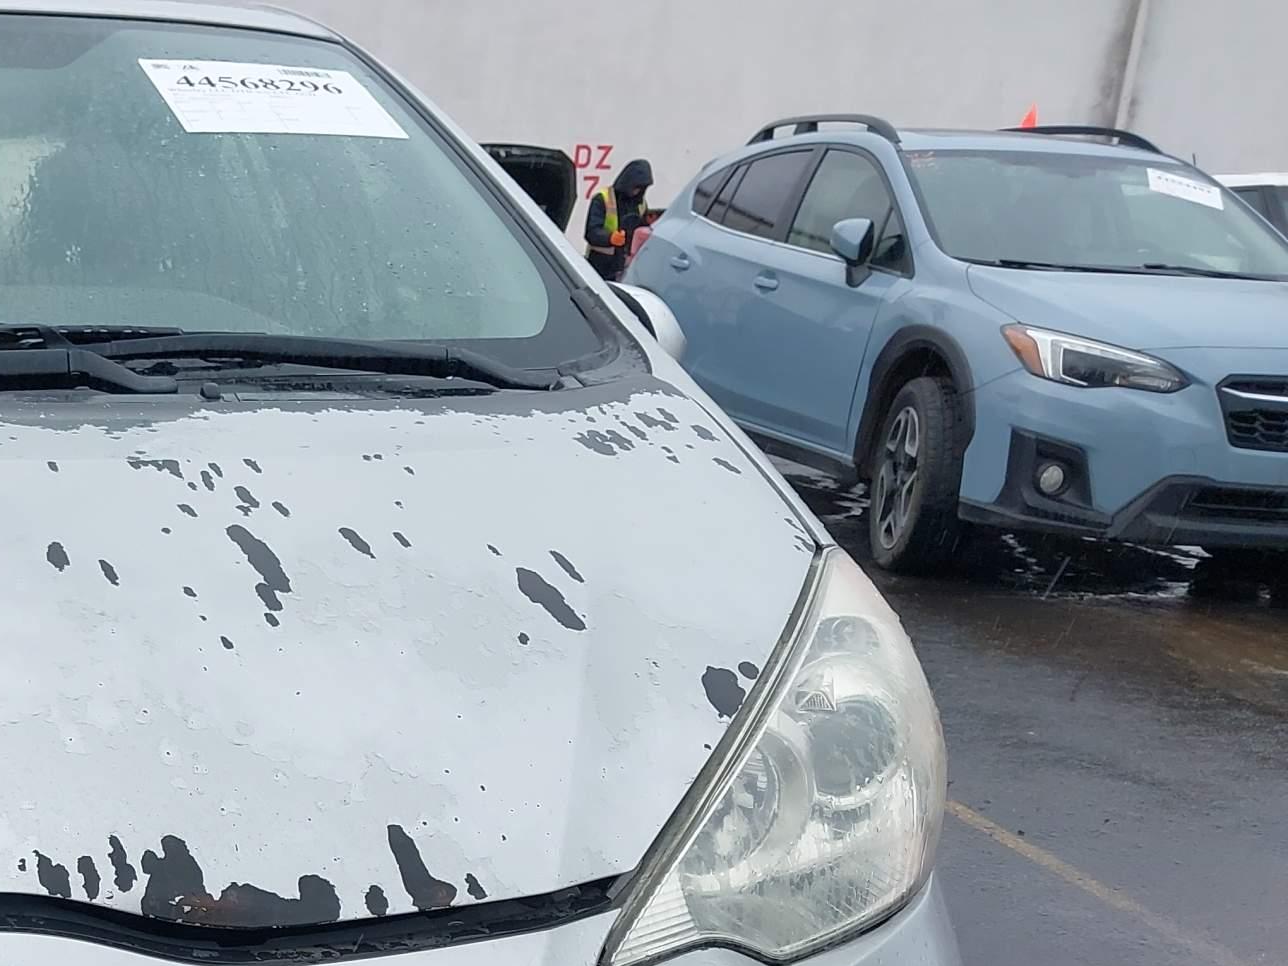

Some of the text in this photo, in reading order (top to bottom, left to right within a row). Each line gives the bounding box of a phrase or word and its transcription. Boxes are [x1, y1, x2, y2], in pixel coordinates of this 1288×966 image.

[176, 75, 343, 95] 44568296
[575, 144, 613, 169] DZ
[584, 176, 600, 200] 7
